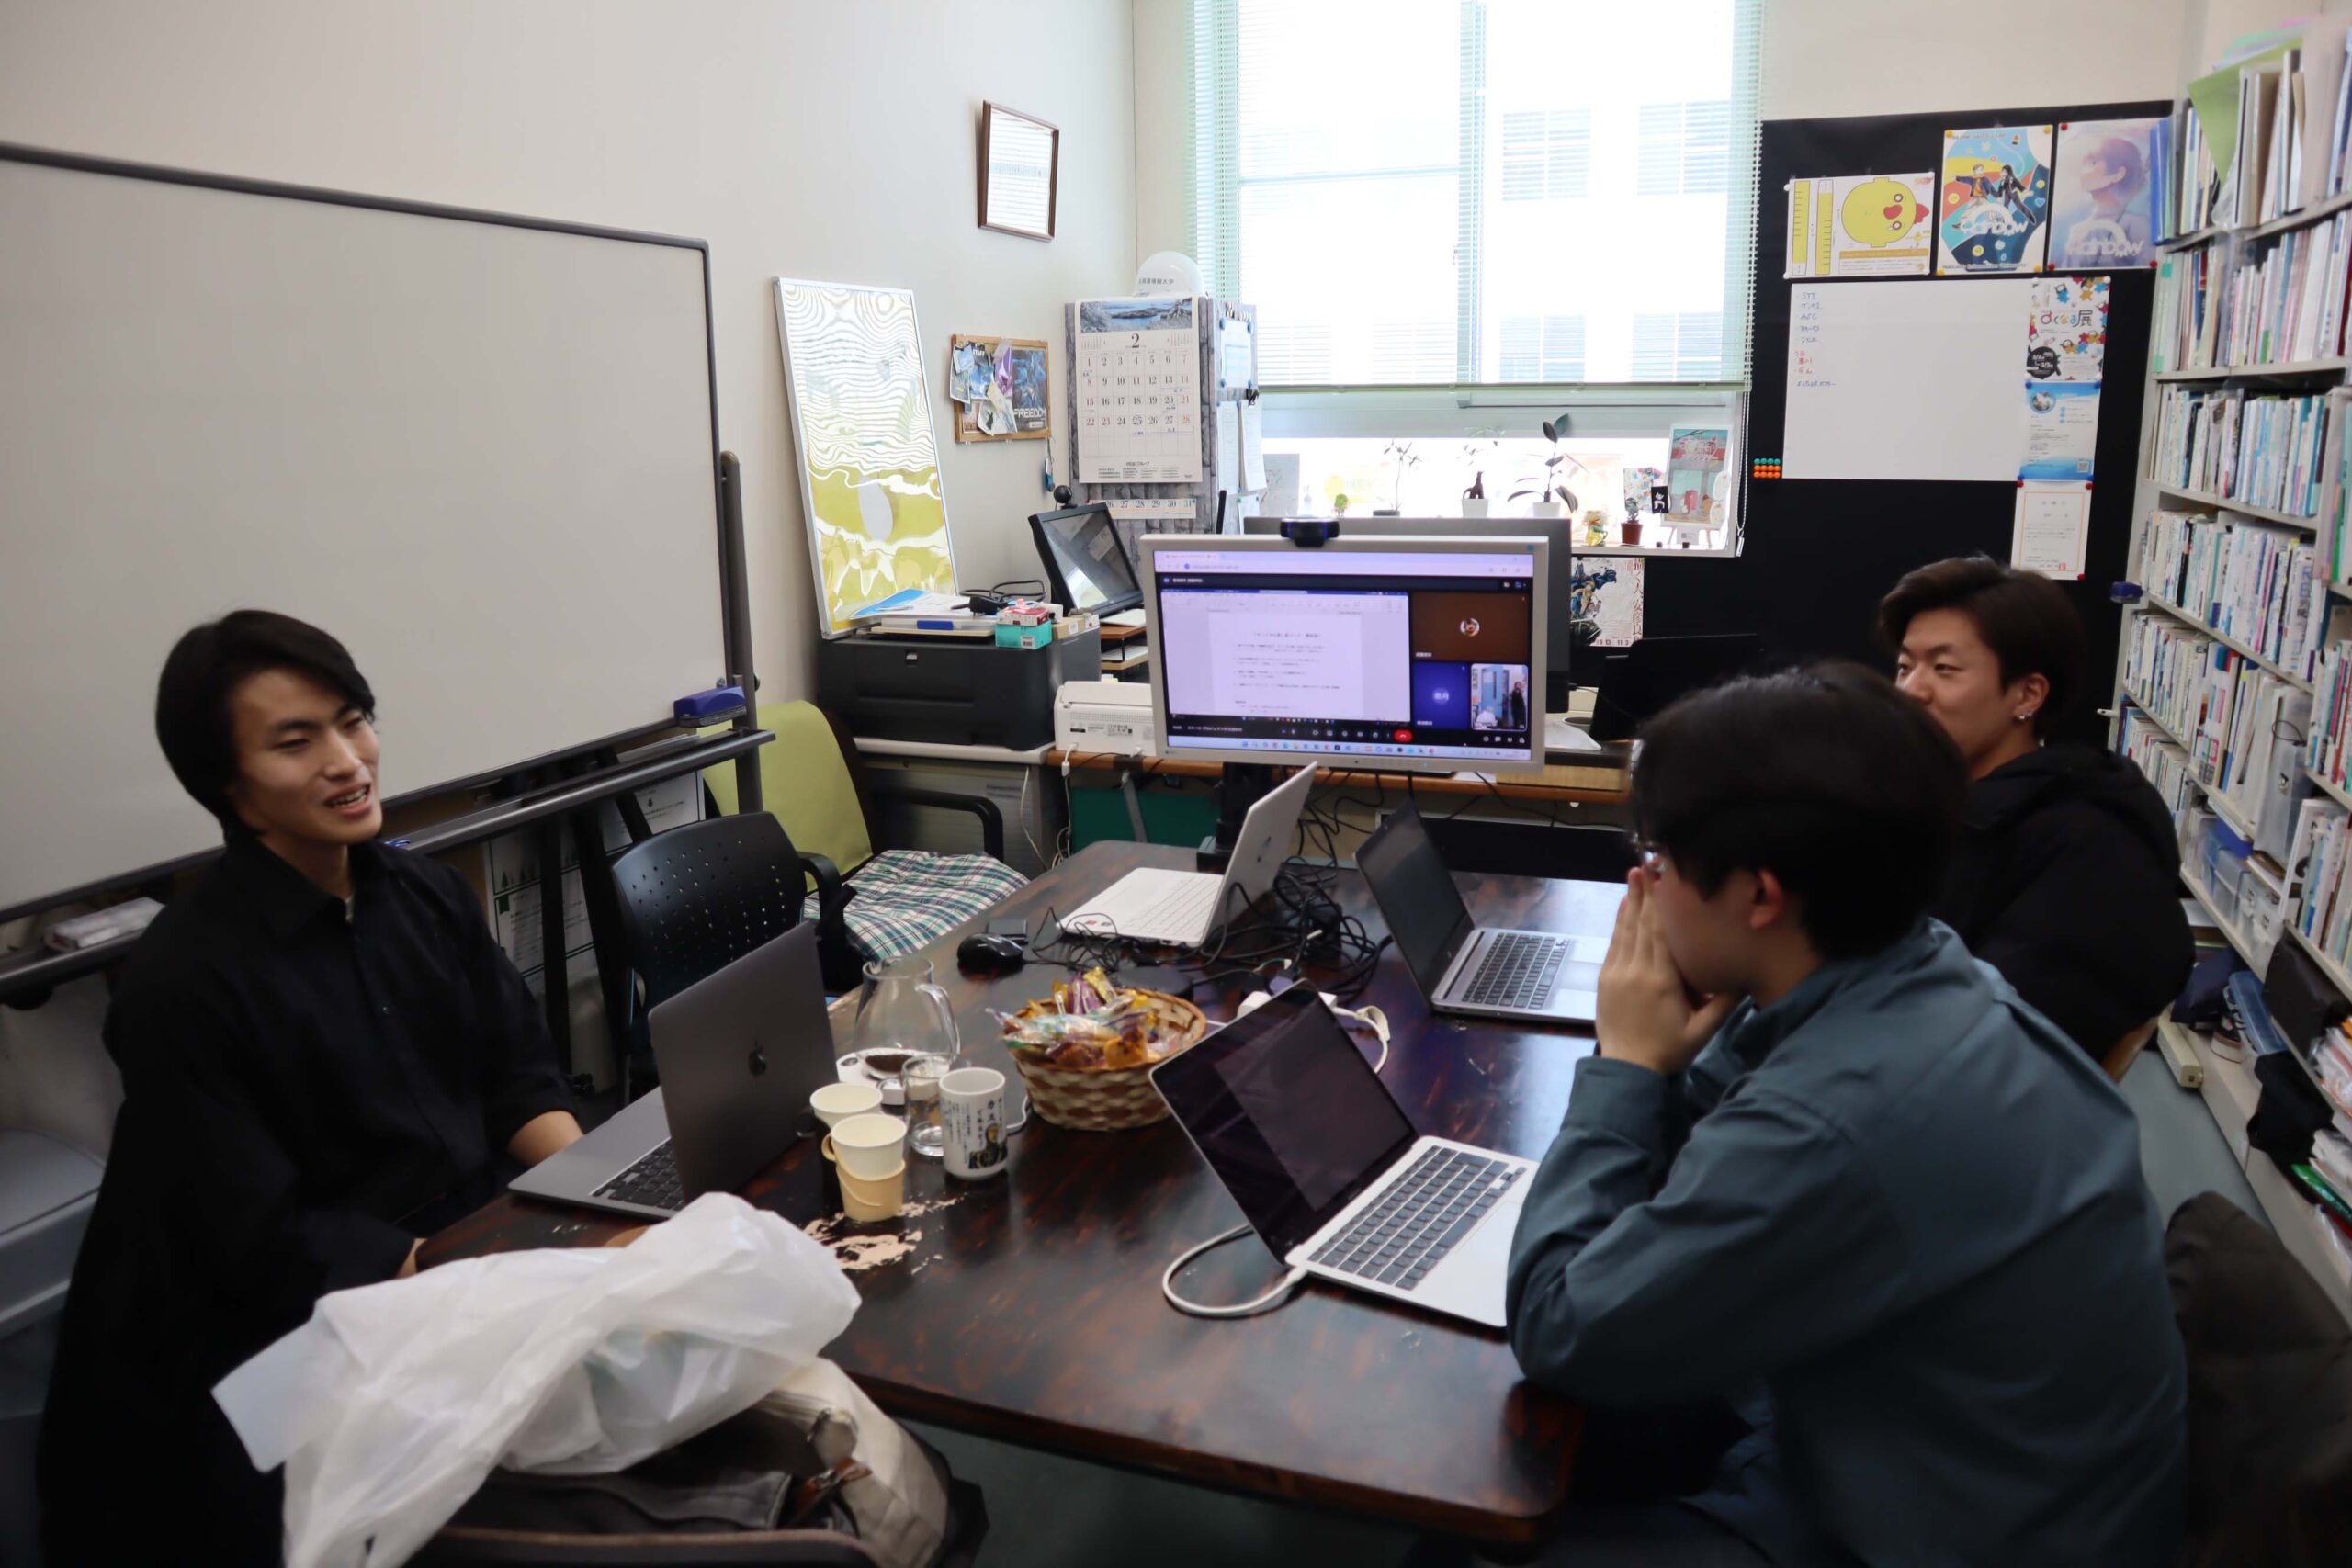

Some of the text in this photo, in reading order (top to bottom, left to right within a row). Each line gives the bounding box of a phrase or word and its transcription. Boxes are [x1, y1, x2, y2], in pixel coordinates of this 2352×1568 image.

[1131, 333, 1140, 348] 2
[1117, 377, 1125, 386] 10
[1133, 377, 1140, 385] 11
[1148, 376, 1157, 385] 12
[1165, 376, 1173, 384] 13
[1182, 375, 1189, 384] 14
[1087, 395, 1190, 406] 15 16 17 18 19 20 21
[1086, 415, 1190, 426] 22 23 24 25 26 27 28
[1120, 500, 1129, 508] 27
[1136, 500, 1145, 508] 28
[1151, 500, 1160, 508] 29
[1167, 499, 1176, 508] 30
